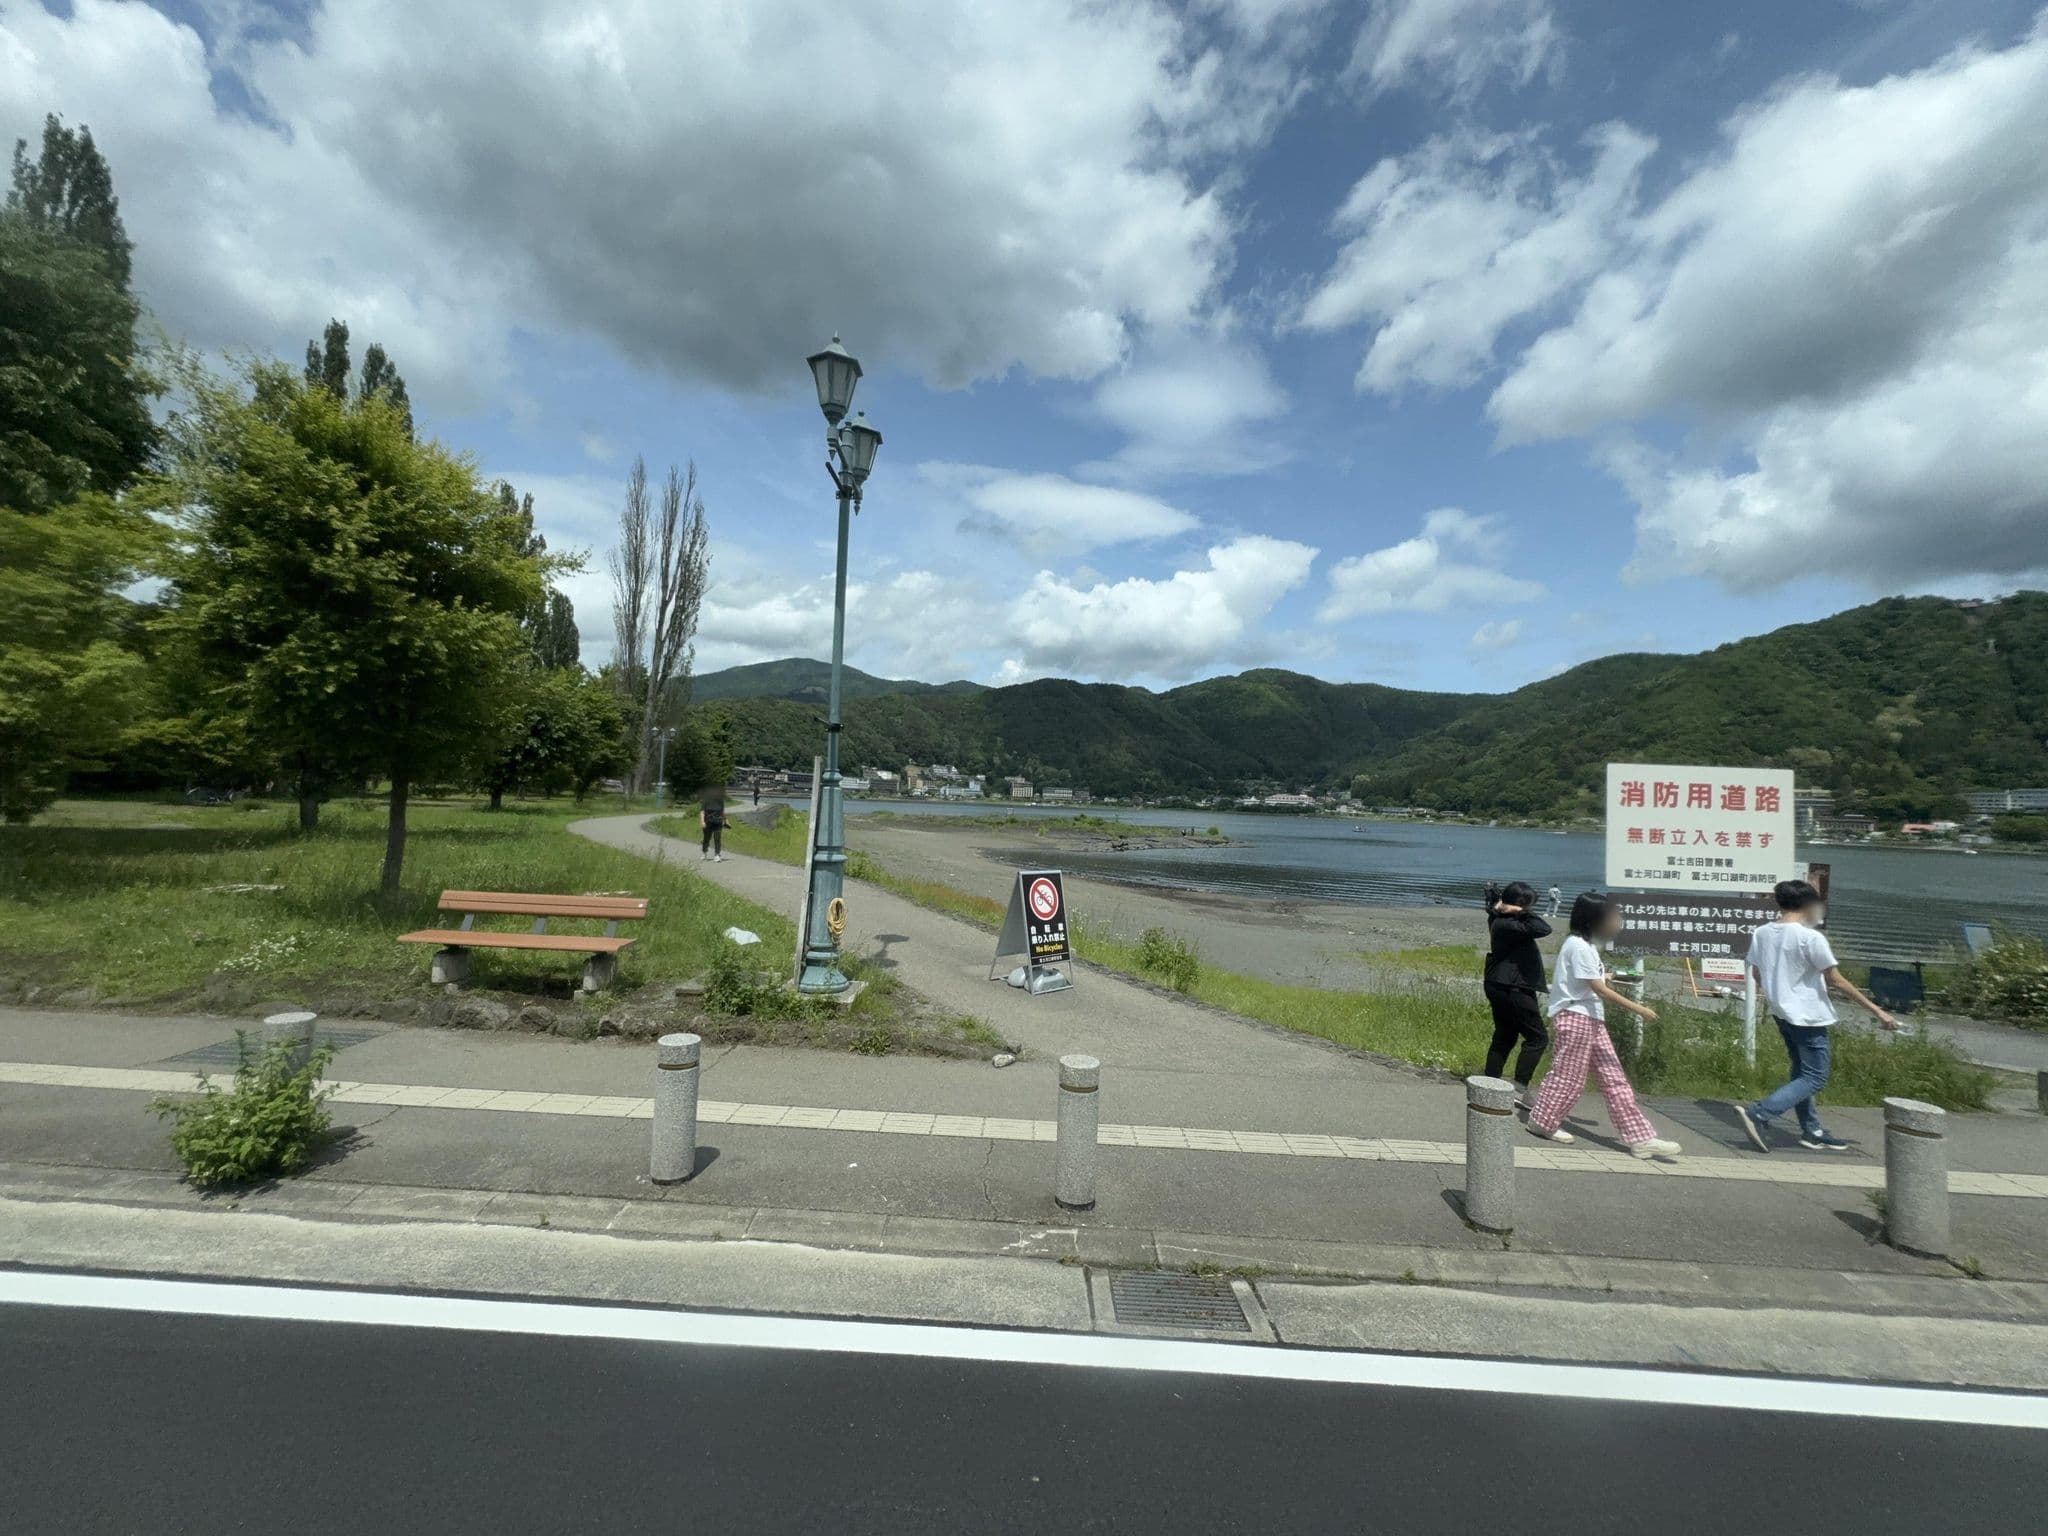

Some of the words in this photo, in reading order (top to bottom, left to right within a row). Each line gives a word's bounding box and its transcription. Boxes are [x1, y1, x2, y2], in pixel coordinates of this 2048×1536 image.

[1620, 781, 1780, 813] 消防用道路
[1666, 856, 1734, 868] 富士吉田警察署
[1624, 869, 1681, 880] 富士河口湖町
[1691, 871, 1777, 884] 富士河口湖町消防団
[1615, 904, 1782, 920] これより先は車の進入はできません
[1669, 941, 1731, 954] 富士河口湖町
